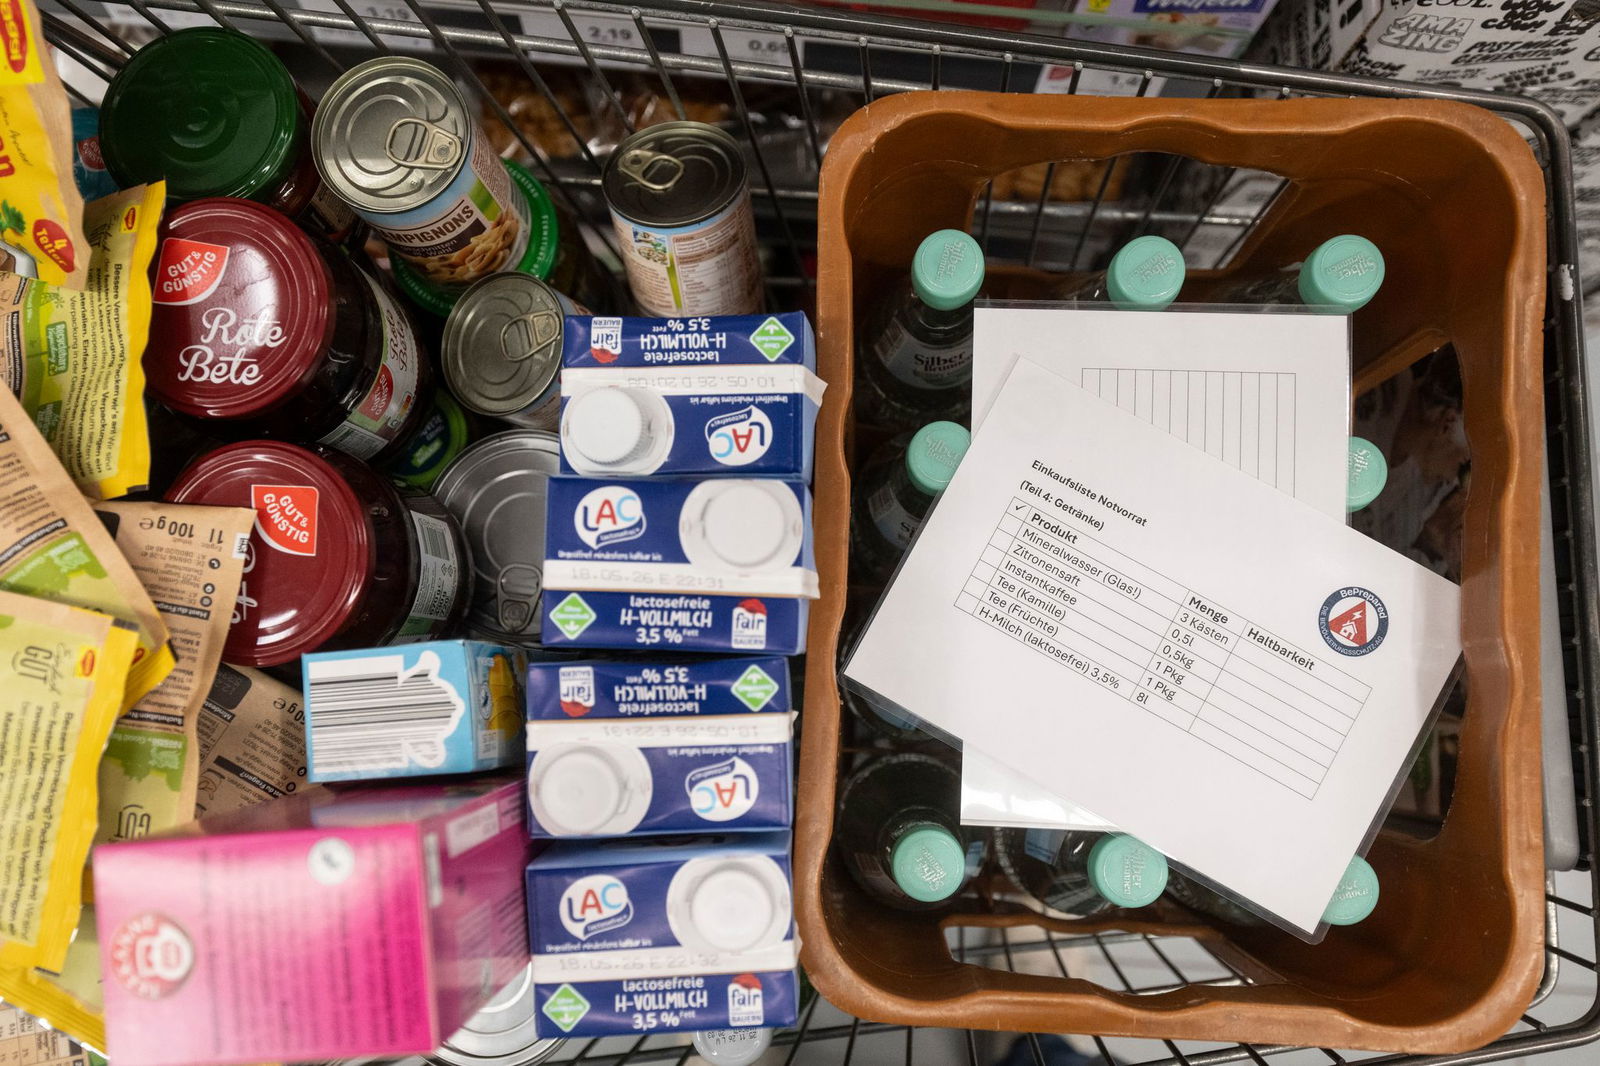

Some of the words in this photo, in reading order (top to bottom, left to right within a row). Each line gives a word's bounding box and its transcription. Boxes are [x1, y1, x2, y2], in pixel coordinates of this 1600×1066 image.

[587, 26, 632, 40] 2.19
[36, 228, 68, 266] Teller
[55, 239, 67, 250] 4
[114, 264, 122, 299] Bessere
[163, 251, 217, 293] GÜNSTIG
[113, 301, 126, 362] Verpackung?
[200, 307, 287, 348] Rote
[687, 318, 711, 331] 3,5
[592, 330, 621, 349] fair
[640, 332, 727, 350] H-VOLLMILCH
[177, 344, 264, 386] Bete
[643, 351, 720, 362] lactosefreie
[914, 351, 967, 370] Silber
[96, 391, 109, 457] Verpackungen
[714, 421, 766, 458] LAC
[1019, 480, 1042, 499] (Teil
[1043, 492, 1053, 503] 4:
[1054, 498, 1105, 532] Getränke)
[1032, 459, 1097, 500] Einkaufsliste
[1098, 494, 1149, 527] Notvorrat
[155, 515, 167, 530] g
[264, 493, 310, 544] GÜNSTIG
[583, 494, 638, 531] LAC
[168, 521, 195, 539] 100
[1031, 512, 1078, 544] Produkt
[1012, 544, 1082, 587] Zitronensaft
[1022, 528, 1103, 577] Mineralwasser
[1102, 571, 1142, 600] (Glas!)
[1004, 560, 1078, 605] Instantkaffee
[630, 595, 710, 609] lactosefreie
[997, 575, 1016, 594] Tee
[1016, 587, 1067, 621] (Kamille)
[1188, 596, 1229, 625] Menge
[1340, 587, 1388, 619] BePrepared
[619, 609, 713, 628] H-VOLLMILCH
[734, 613, 765, 632] fair
[988, 591, 1007, 608] Tee
[1007, 602, 1059, 638] (Früchte)
[1180, 612, 1189, 623] 3
[1190, 616, 1230, 645] Kästen
[635, 628, 661, 645] 3,5
[978, 606, 1023, 636] H-Milch
[1023, 631, 1091, 674] (laktosefrei)
[1090, 667, 1120, 689] 3,5%
[1247, 627, 1315, 671] Haltbarkeit
[18, 645, 53, 685] GUT
[1162, 644, 1195, 670] 0,5kg
[664, 668, 690, 682] 3,5
[1163, 664, 1186, 685] Pkg
[562, 684, 592, 703] fair
[614, 684, 706, 702] H-VOLLMILCH
[1154, 680, 1177, 701] Pkg
[204, 702, 233, 721] Mindest
[618, 702, 699, 714] lactosefreie
[695, 775, 751, 814] LAC
[567, 883, 622, 923] LAC
[622, 977, 705, 992] lactosefreie
[731, 988, 761, 1008] fair
[614, 991, 709, 1013] H-VOLLMILCH
[632, 1014, 657, 1030] 3,5
